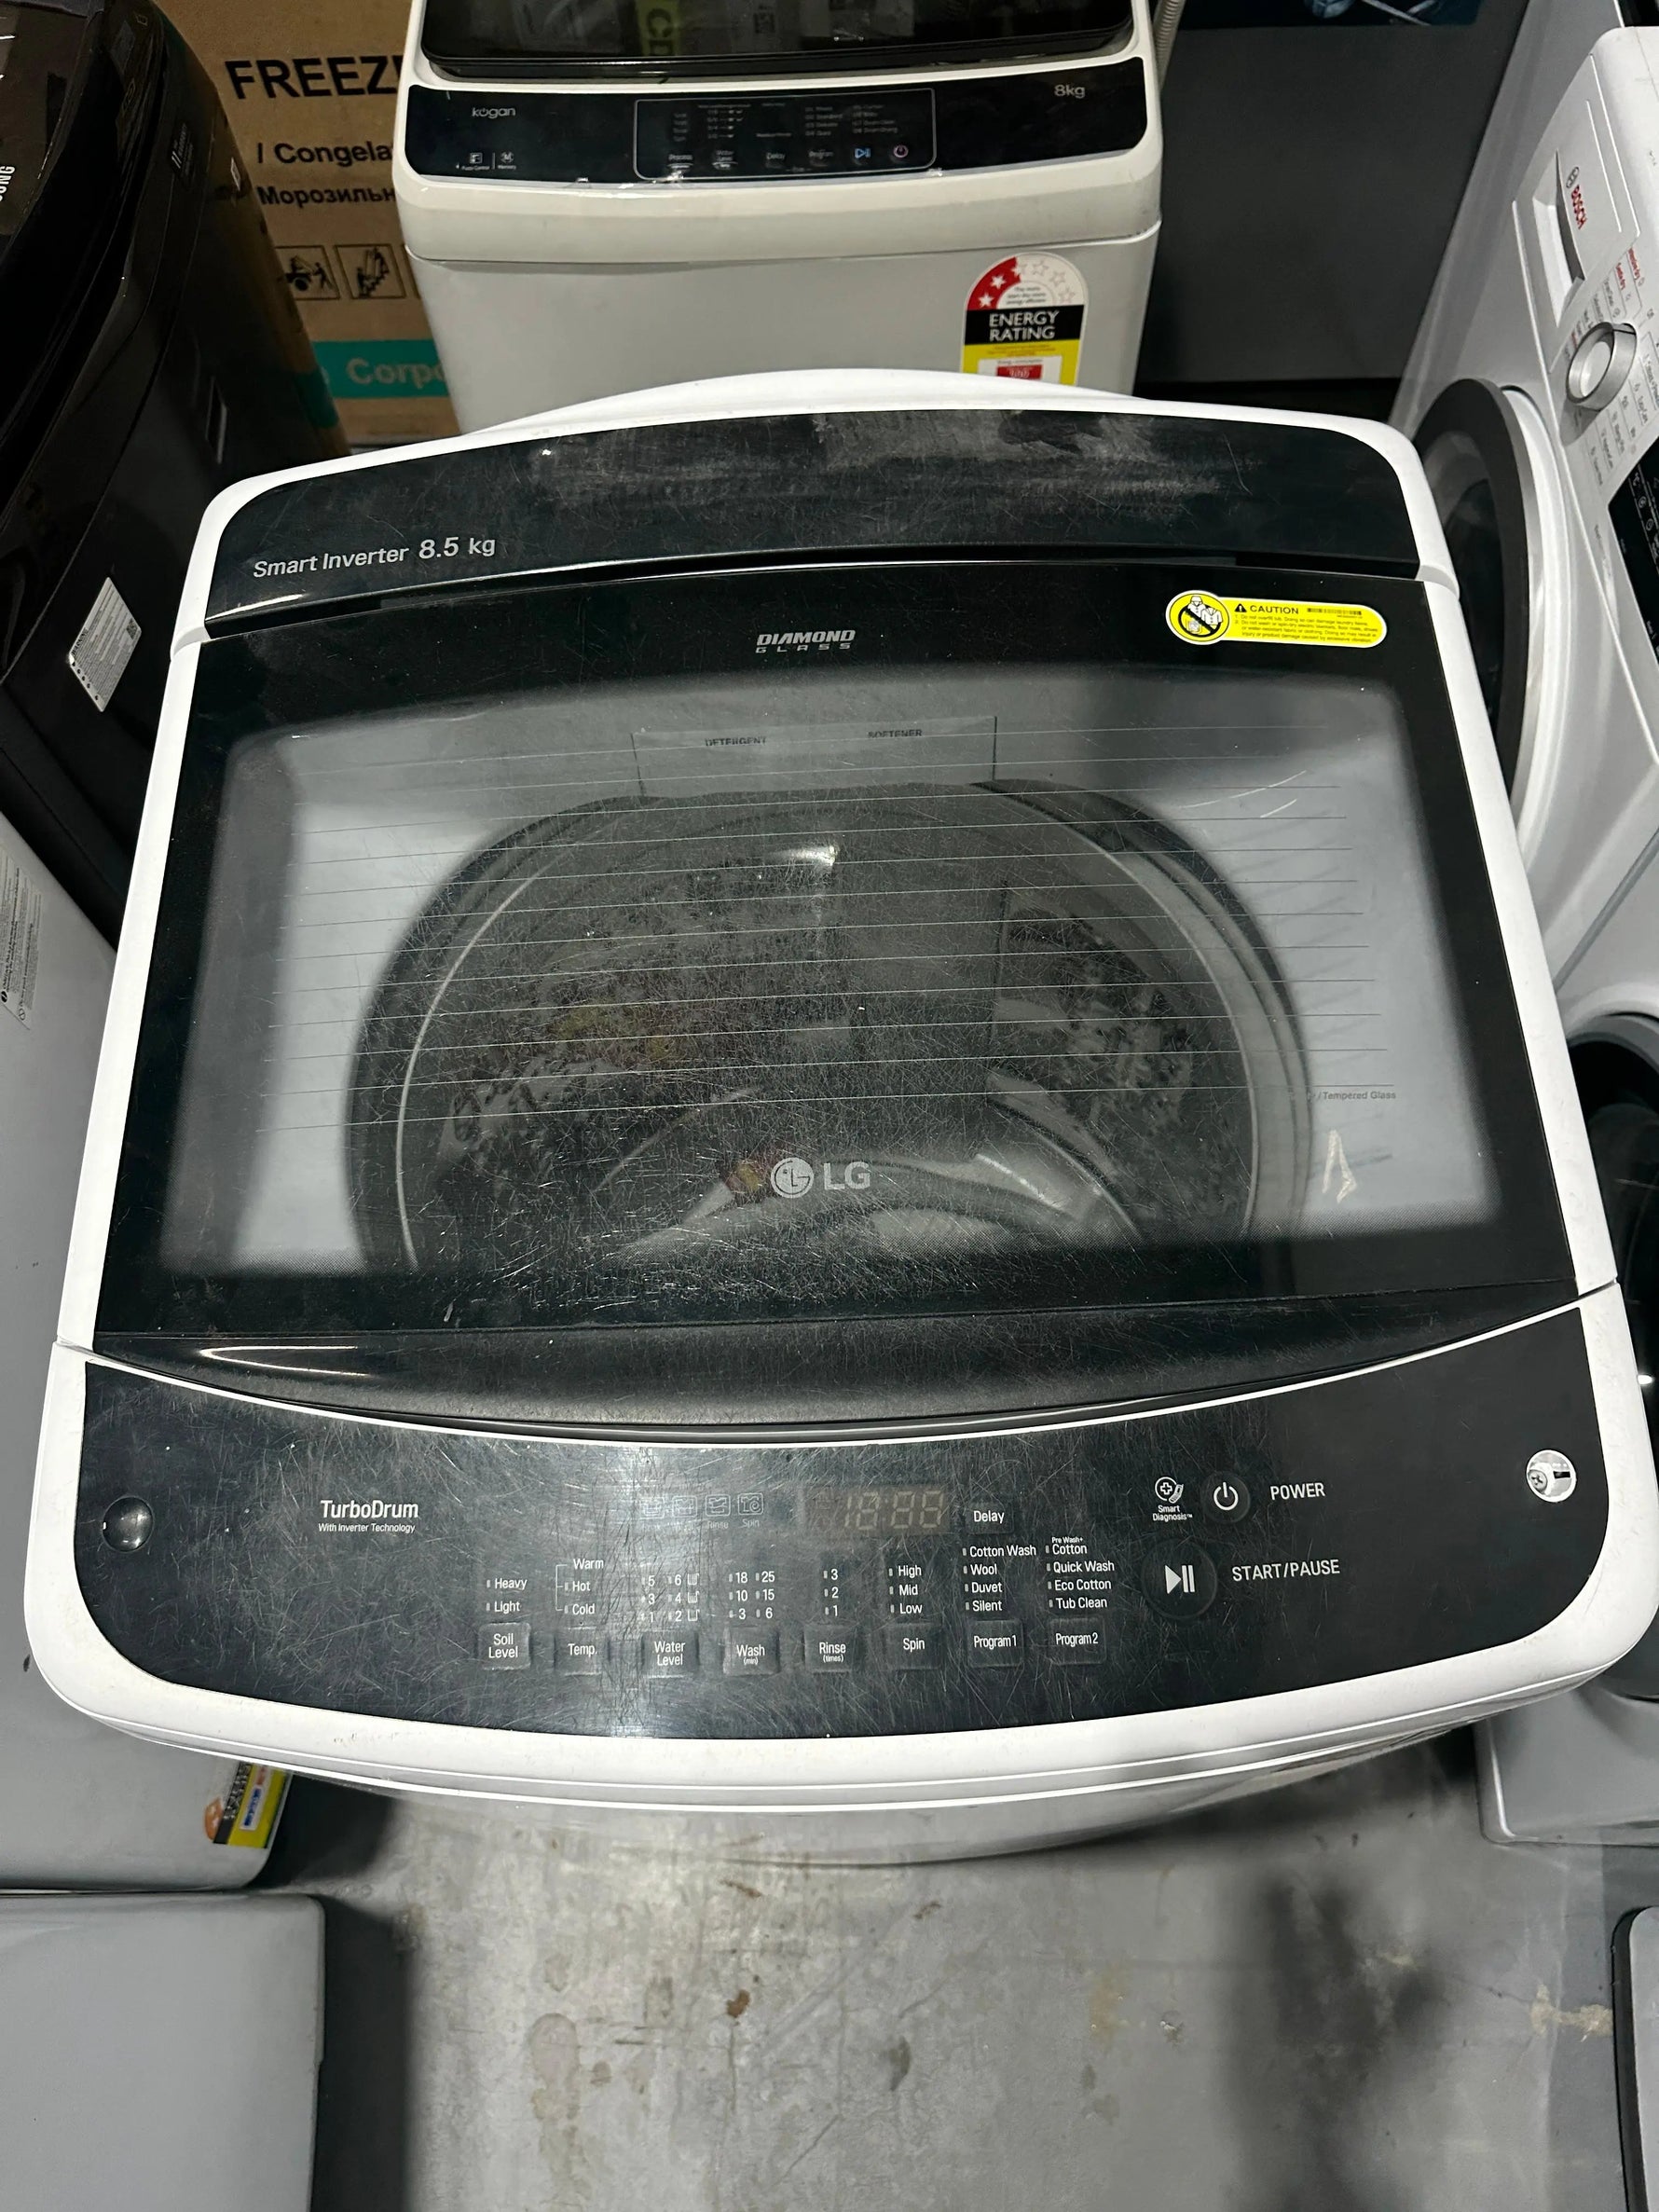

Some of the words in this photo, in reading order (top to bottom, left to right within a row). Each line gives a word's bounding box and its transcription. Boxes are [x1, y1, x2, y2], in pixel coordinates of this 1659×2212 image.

[1054, 84, 1085, 98] 8kg
[472, 107, 516, 119] kogan
[989, 310, 1060, 327] ENERGY
[989, 326, 1056, 342] RATING
[253, 556, 318, 577] Smart
[322, 547, 409, 570] Inverter
[418, 537, 459, 559] 8.5
[468, 537, 496, 557] kg
[1250, 605, 1299, 614] CAUTION
[756, 630, 856, 646] DIAMOND
[755, 643, 851, 653] GLASS
[1323, 1091, 1367, 1100] Tempered
[1370, 1091, 1396, 1099] Glass
[824, 1161, 871, 1190] LG
[1270, 1482, 1325, 1500] POWER
[320, 1500, 419, 1518] TurboDrum
[973, 1510, 1005, 1524] Delay
[319, 1523, 337, 1532] With
[338, 1523, 369, 1532] Inverter
[371, 1523, 415, 1533] Technology
[707, 1520, 728, 1530] Rinse
[742, 1518, 760, 1529] Spin
[970, 1546, 1004, 1558] Cotton
[1006, 1545, 1037, 1556] Wash
[1052, 1543, 1088, 1555] Cotton
[573, 1559, 604, 1570] Warm
[970, 1564, 998, 1575] Wool
[1053, 1561, 1083, 1574] Quick
[1084, 1560, 1115, 1572] Wash
[1232, 1559, 1341, 1582] START/PAUSE
[735, 1572, 748, 1583] 18
[761, 1571, 775, 1583] 25
[830, 1568, 838, 1580] 3
[898, 1565, 922, 1579] High
[494, 1578, 528, 1590] Heavy
[648, 1575, 655, 1586] 5
[674, 1574, 682, 1585] 6
[1054, 1580, 1074, 1592] Eco
[1076, 1578, 1112, 1590] Cotton
[572, 1581, 590, 1592] Hot
[898, 1584, 919, 1596] Mid
[971, 1581, 1003, 1594] Duvet
[648, 1593, 655, 1605] 3
[674, 1592, 682, 1603] 4
[736, 1590, 748, 1601] 10
[762, 1589, 775, 1601] 15
[831, 1587, 839, 1599] 2
[494, 1601, 521, 1614] Light
[900, 1602, 923, 1614] Low
[972, 1600, 1003, 1612] Silent
[1056, 1597, 1075, 1609] Tub
[1077, 1596, 1108, 1608] Clean
[572, 1603, 595, 1615] Cold
[738, 1607, 746, 1620] 3
[765, 1607, 773, 1619] 6
[832, 1605, 838, 1617] 1
[650, 1611, 654, 1623] 1
[675, 1610, 682, 1622] 2
[493, 1633, 514, 1645] Soil
[903, 1637, 925, 1652] Spin
[488, 1646, 519, 1659] Level
[568, 1642, 598, 1658] Temp.
[654, 1641, 686, 1653] Water
[736, 1644, 765, 1656] Wash
[819, 1642, 846, 1655] Rinse
[657, 1653, 683, 1666] Level
[743, 1656, 758, 1665] (min)
[822, 1655, 844, 1663] (times)
